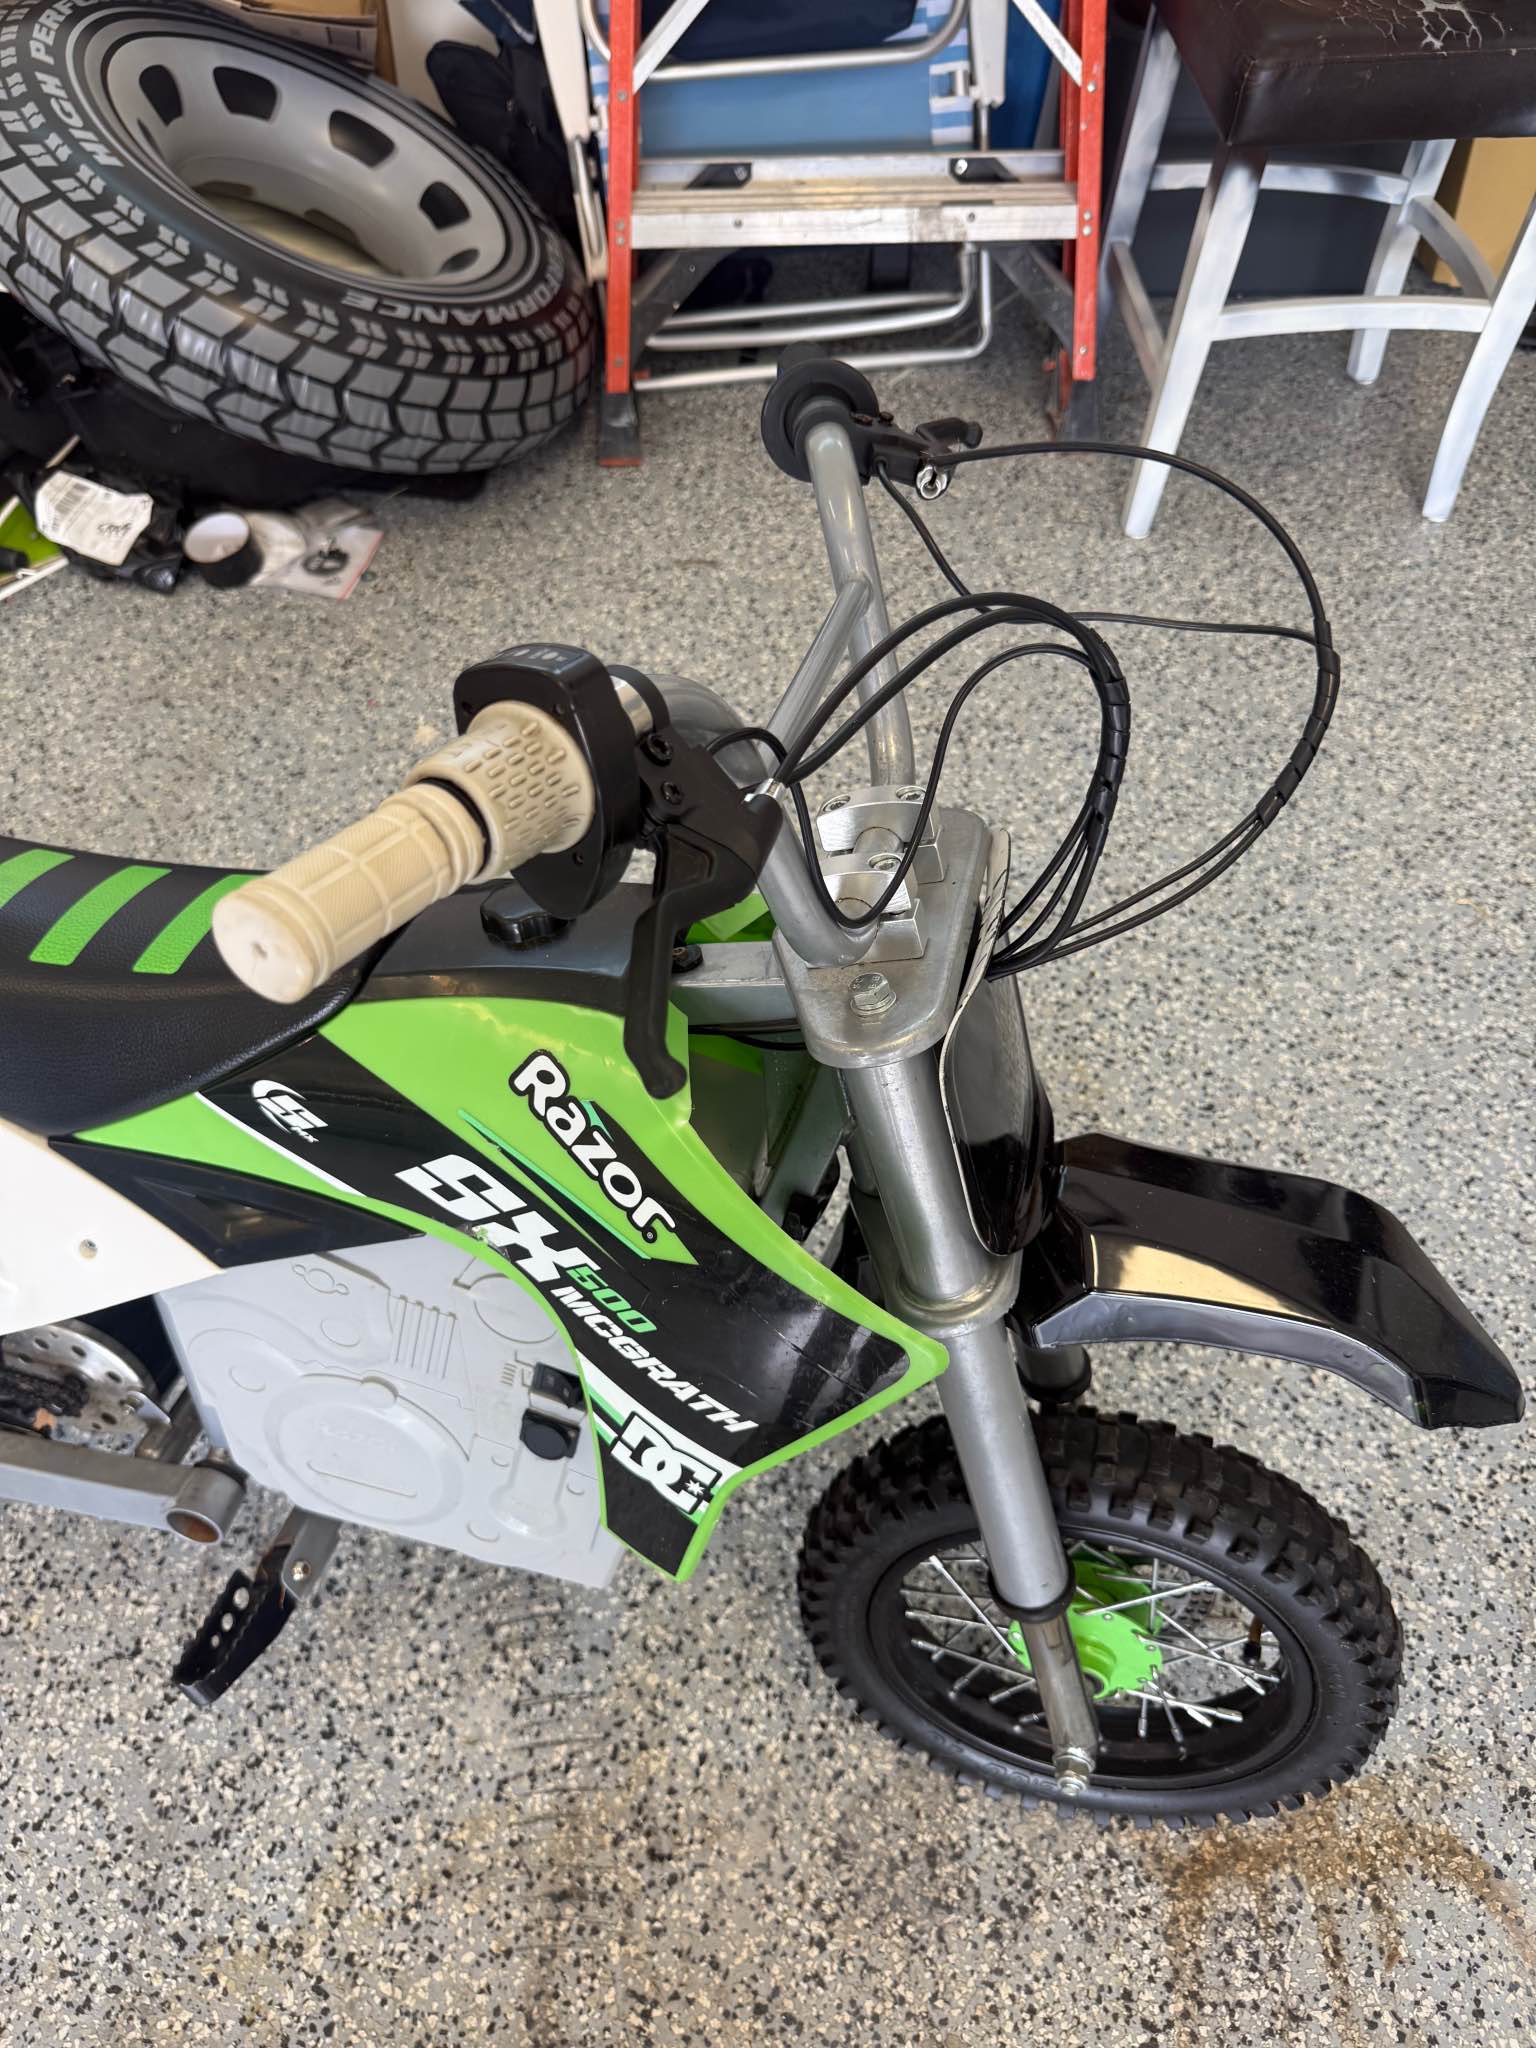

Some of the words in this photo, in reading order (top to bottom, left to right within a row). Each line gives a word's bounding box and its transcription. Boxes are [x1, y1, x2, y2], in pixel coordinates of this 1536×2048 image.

[34, 71, 124, 168] HIGH
[512, 1053, 678, 1231] Razor
[566, 1266, 658, 1334] 500
[550, 1285, 760, 1433] MCGRATH
[610, 1414, 718, 1513] DC
